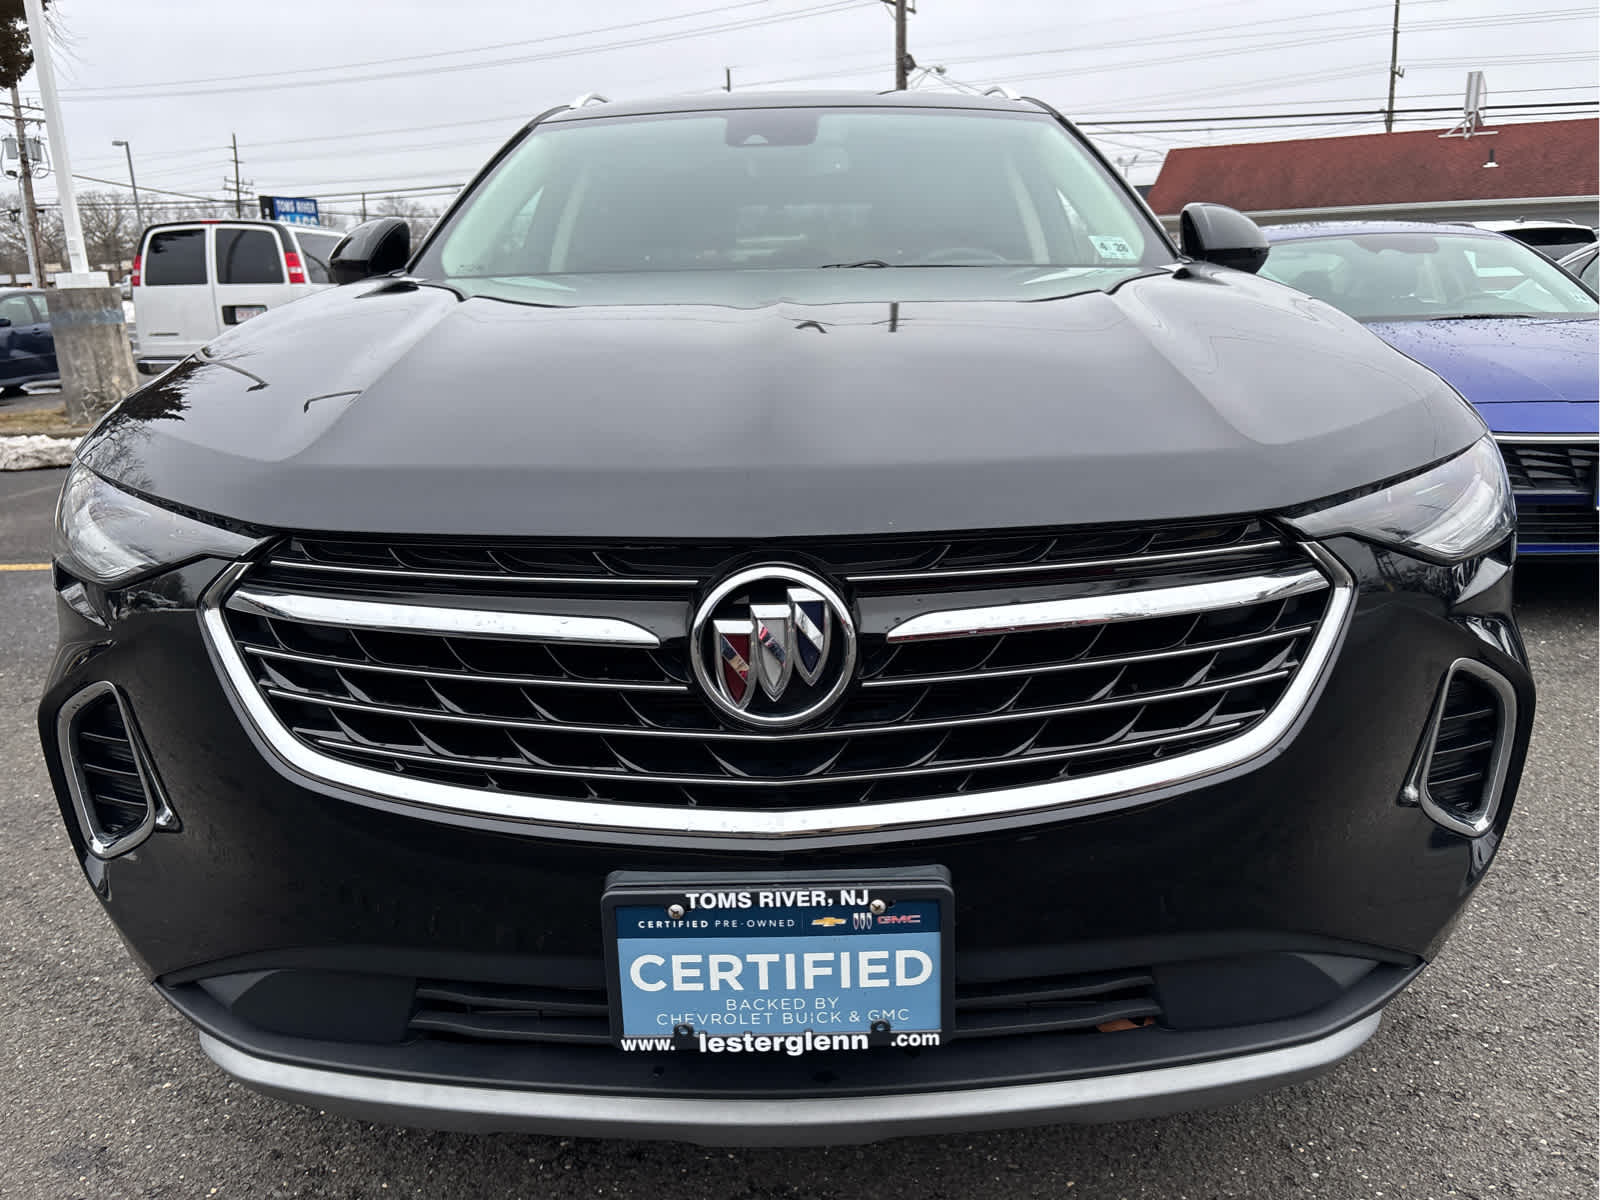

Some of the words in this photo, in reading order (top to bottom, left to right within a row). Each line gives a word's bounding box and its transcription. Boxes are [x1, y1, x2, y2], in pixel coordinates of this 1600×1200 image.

[685, 891, 752, 909] TOMS
[759, 889, 833, 908] RIVER,
[841, 889, 869, 906] NJ
[638, 920, 709, 929] CERTIFIED
[715, 919, 795, 928] PRE-OWNED
[877, 914, 921, 925] GMC
[630, 949, 933, 992] CERTIFIED
[726, 998, 806, 1011] BACKED
[815, 997, 839, 1010] BY
[656, 1012, 774, 1026] CHEVROLET
[782, 1011, 842, 1025] BUICK
[848, 1010, 861, 1023] &
[867, 1008, 910, 1022] GMC
[620, 1038, 676, 1052] www.
[699, 1031, 869, 1056] lesterglenn
[890, 1032, 940, 1047] .com
